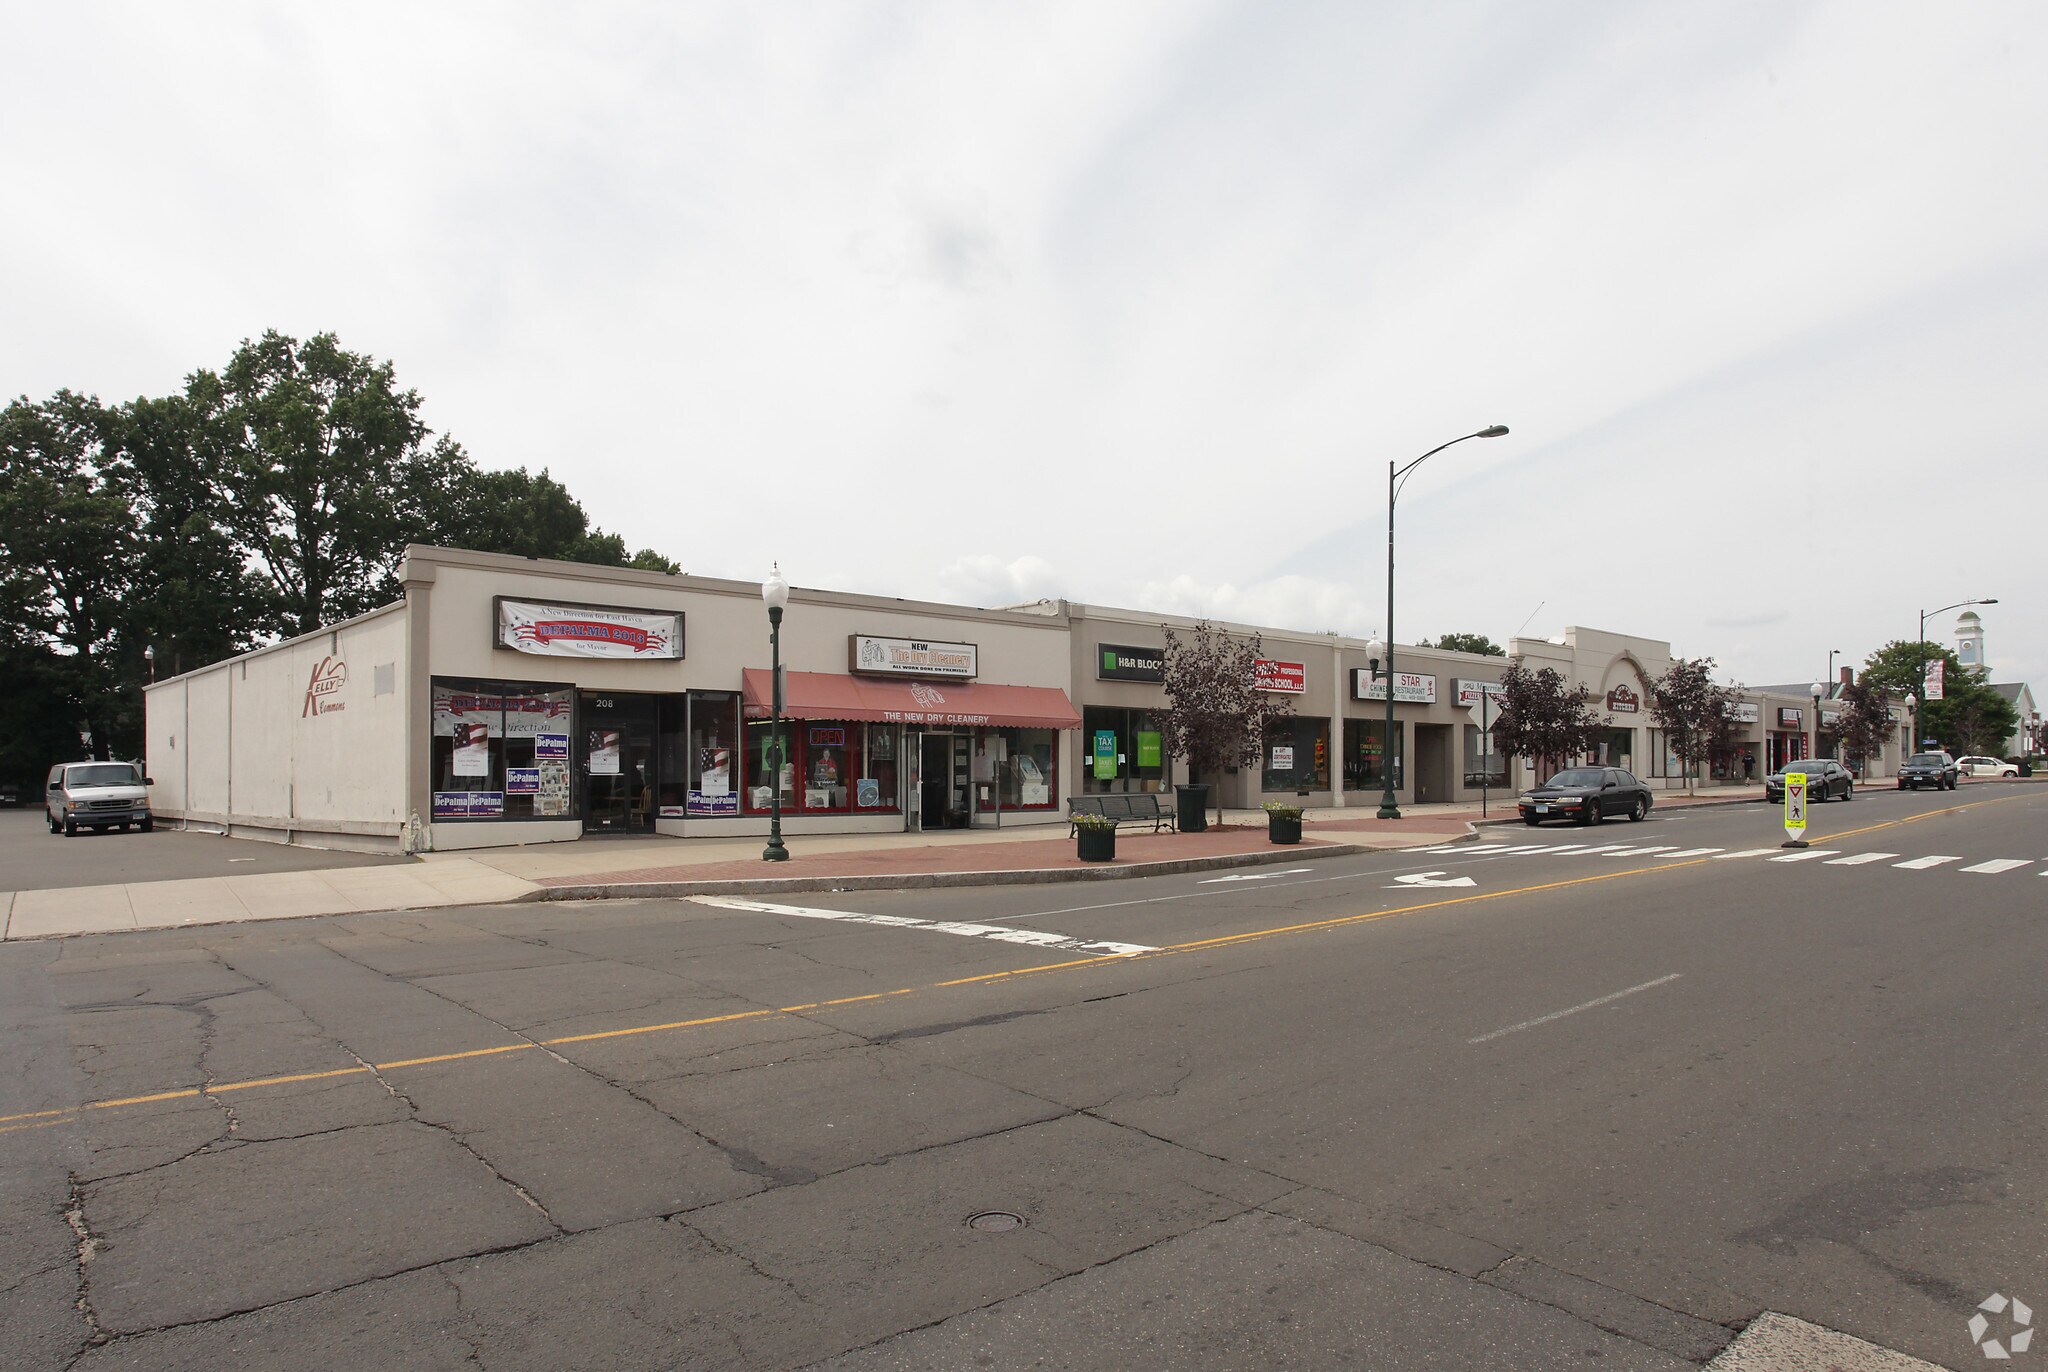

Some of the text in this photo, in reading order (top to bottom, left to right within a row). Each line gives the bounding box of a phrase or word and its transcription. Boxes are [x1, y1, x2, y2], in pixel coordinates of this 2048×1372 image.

[563, 610, 593, 618] Direction
[539, 624, 645, 643] DEPALMA 2013
[587, 643, 608, 651] Mayor
[911, 642, 928, 651] NEW
[890, 648, 971, 669] The Dry Cleanery
[1118, 657, 1136, 668] H&R
[1274, 678, 1293, 689] SCHOOL
[1401, 675, 1421, 687] STAR
[1370, 684, 1426, 695] CHINE RESTAURANT
[596, 699, 613, 708] 208
[883, 711, 989, 724] THE NEW DRY CLEANERY
[811, 730, 843, 743] OPEN
[537, 739, 567, 748] DePalma
[1098, 737, 1113, 746] TAX
[508, 774, 539, 783] DePalma
[434, 797, 468, 806] DePalma
[470, 797, 502, 806] DePalma
[689, 796, 711, 804] DePalm
